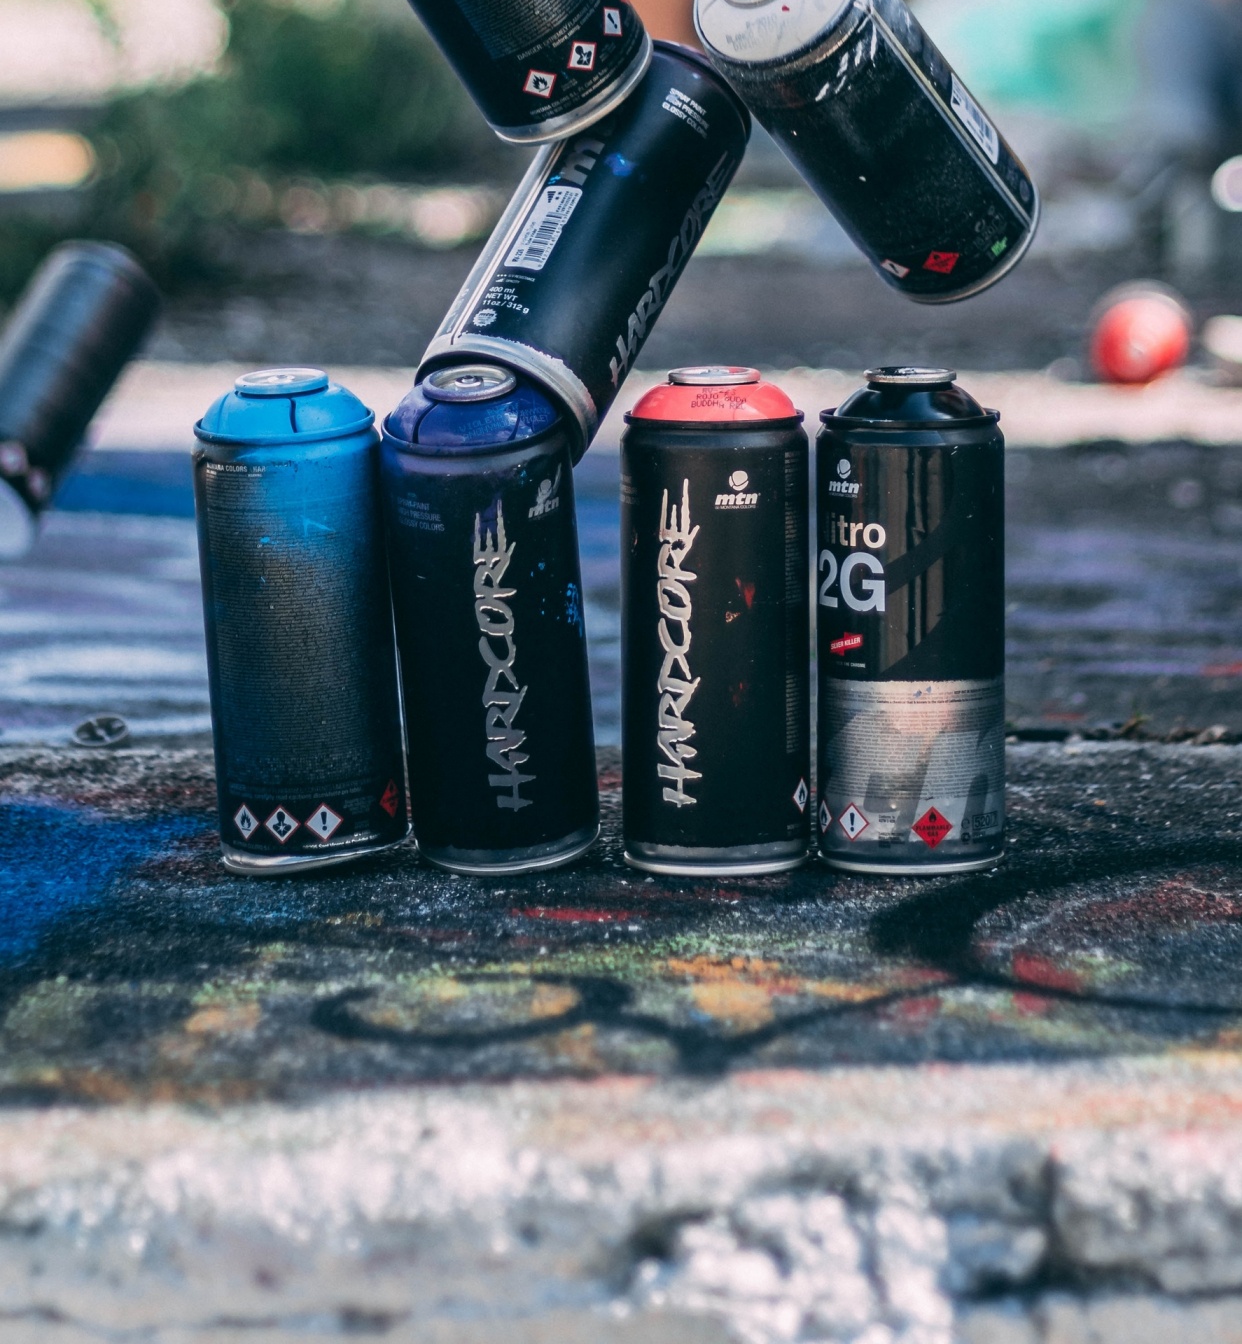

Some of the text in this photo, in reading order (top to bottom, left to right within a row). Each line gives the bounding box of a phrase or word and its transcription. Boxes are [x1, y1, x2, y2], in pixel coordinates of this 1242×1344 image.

[669, 87, 706, 116] SPRAY PAINT
[484, 290, 518, 302] NET WT
[488, 284, 516, 294] 400 ml
[505, 300, 522, 311] 312
[225, 464, 248, 472] COLORS
[828, 480, 860, 494] mtn
[714, 491, 758, 505] mtn
[825, 511, 886, 548] itro
[819, 549, 885, 612] 2G
[657, 478, 702, 807] HARDCORE
[843, 636, 860, 646] KILLER
[473, 499, 536, 812] HARDCORE
